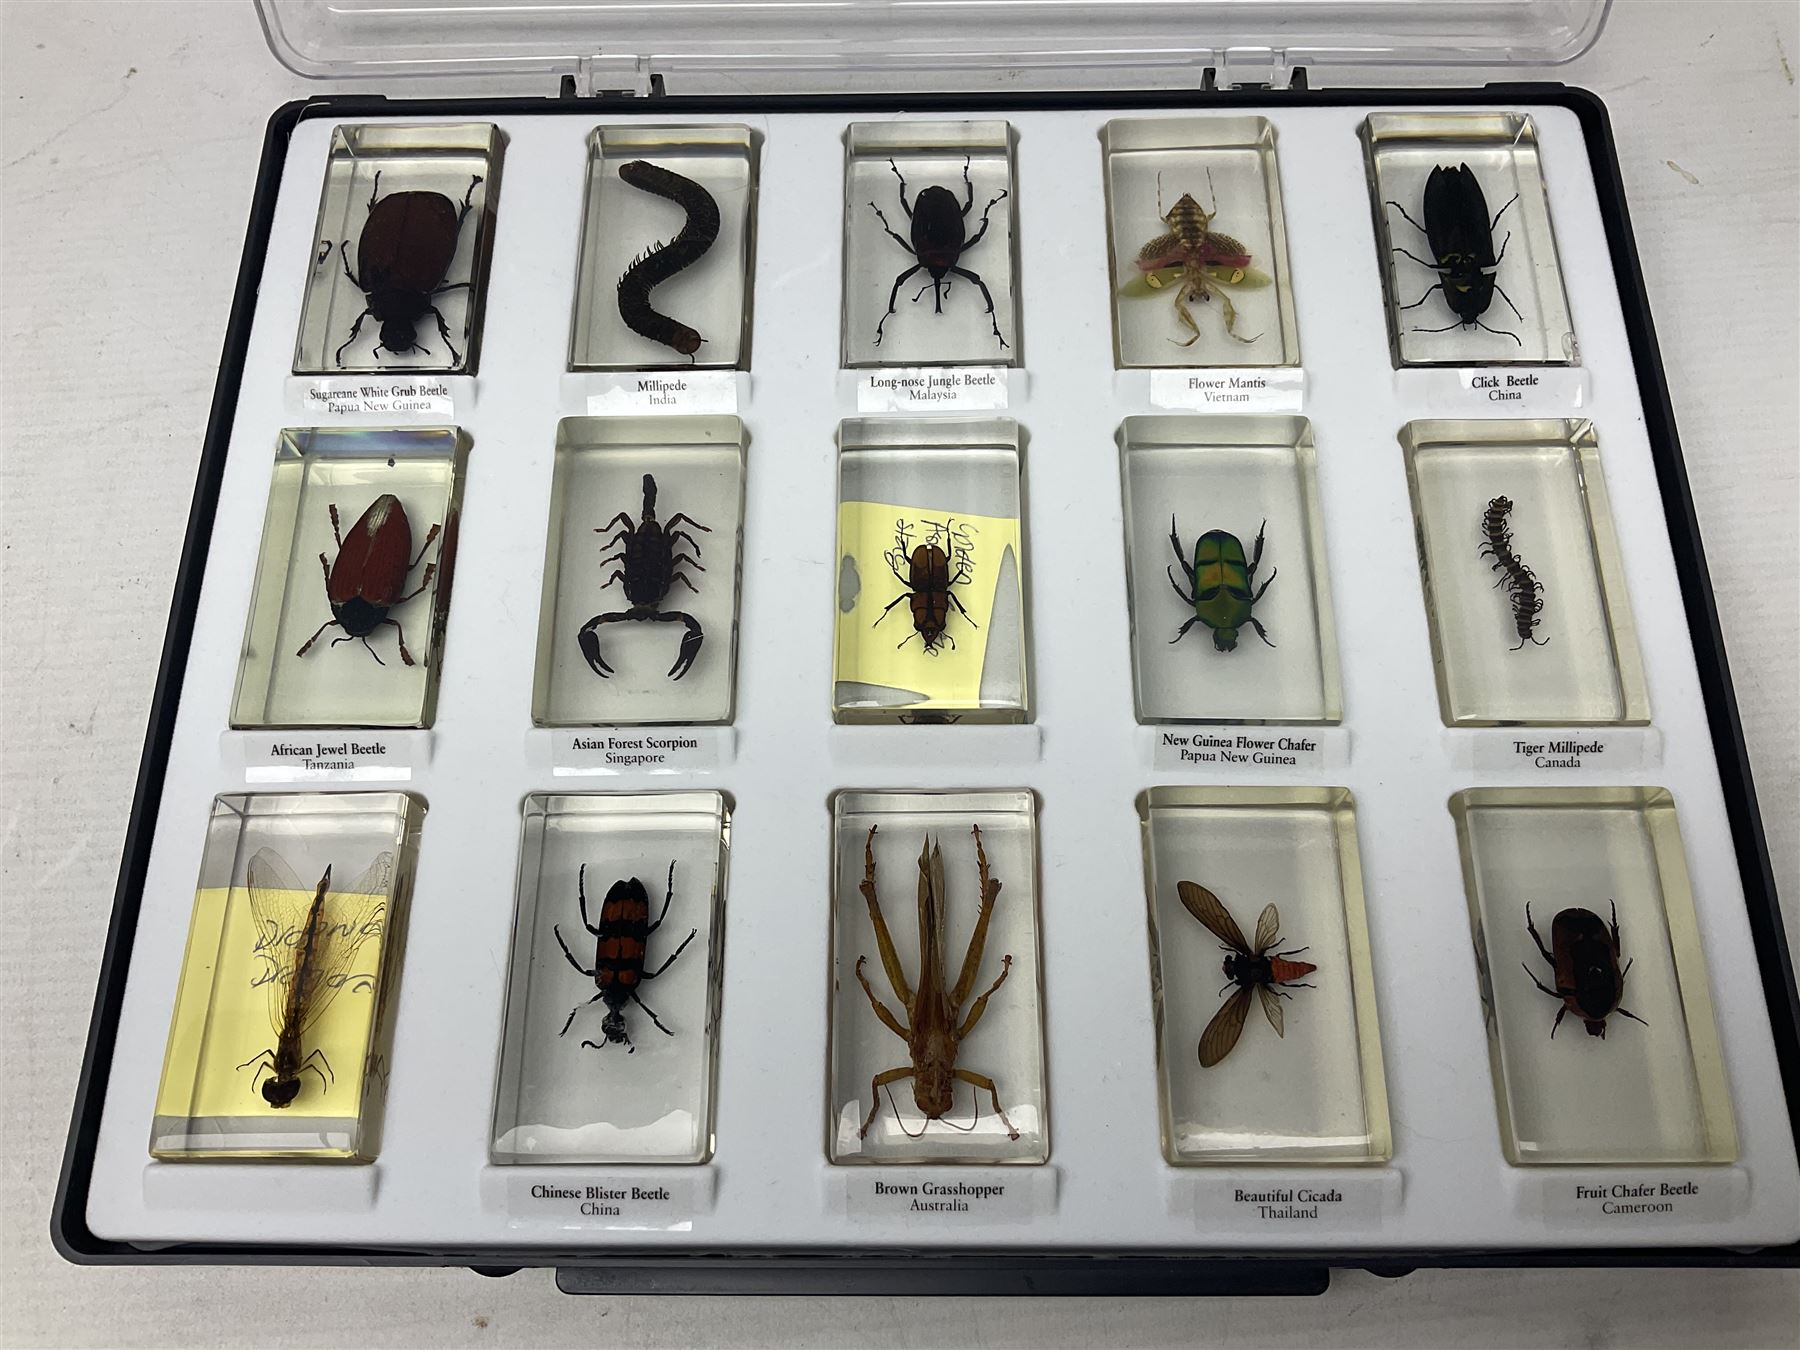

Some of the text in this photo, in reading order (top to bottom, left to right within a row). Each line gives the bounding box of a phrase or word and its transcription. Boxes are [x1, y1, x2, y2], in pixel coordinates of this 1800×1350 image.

[638, 380, 687, 393] Millipede
[871, 374, 995, 389] Long-nose Jungle Beetle
[1189, 377, 1266, 389] Flower Mantis
[1472, 375, 1539, 388] Click Beetle
[310, 384, 447, 401] Sugarcane White Grub Beetle
[910, 390, 957, 402] Malaysia
[1204, 392, 1249, 402] Vietnam
[1489, 390, 1521, 401] China
[649, 395, 677, 405] India
[328, 400, 431, 414] Papua New Guinea
[572, 736, 697, 750] Asian Forest Scorpion
[1162, 734, 1316, 751] New Guinea Flower Chafer
[1513, 741, 1603, 756] Tiger Millipede
[271, 743, 386, 758] African Jewel Beetle
[1181, 749, 1296, 765] Papua New Guinea
[303, 759, 354, 769] Tanzania
[605, 753, 664, 766] Singapore
[1535, 757, 1580, 768] Canada
[531, 1186, 669, 1200] Chinese Blister Beetle
[875, 1182, 1004, 1199] Brown Grasshopper
[1235, 1189, 1342, 1202] Beautiful Cicada
[1576, 1182, 1698, 1198] Fruit Chafer Beetle
[580, 1203, 620, 1216] China
[910, 1199, 968, 1211] Australia
[1602, 1201, 1673, 1214] Cameroon
[1258, 1206, 1318, 1218] Thailand
